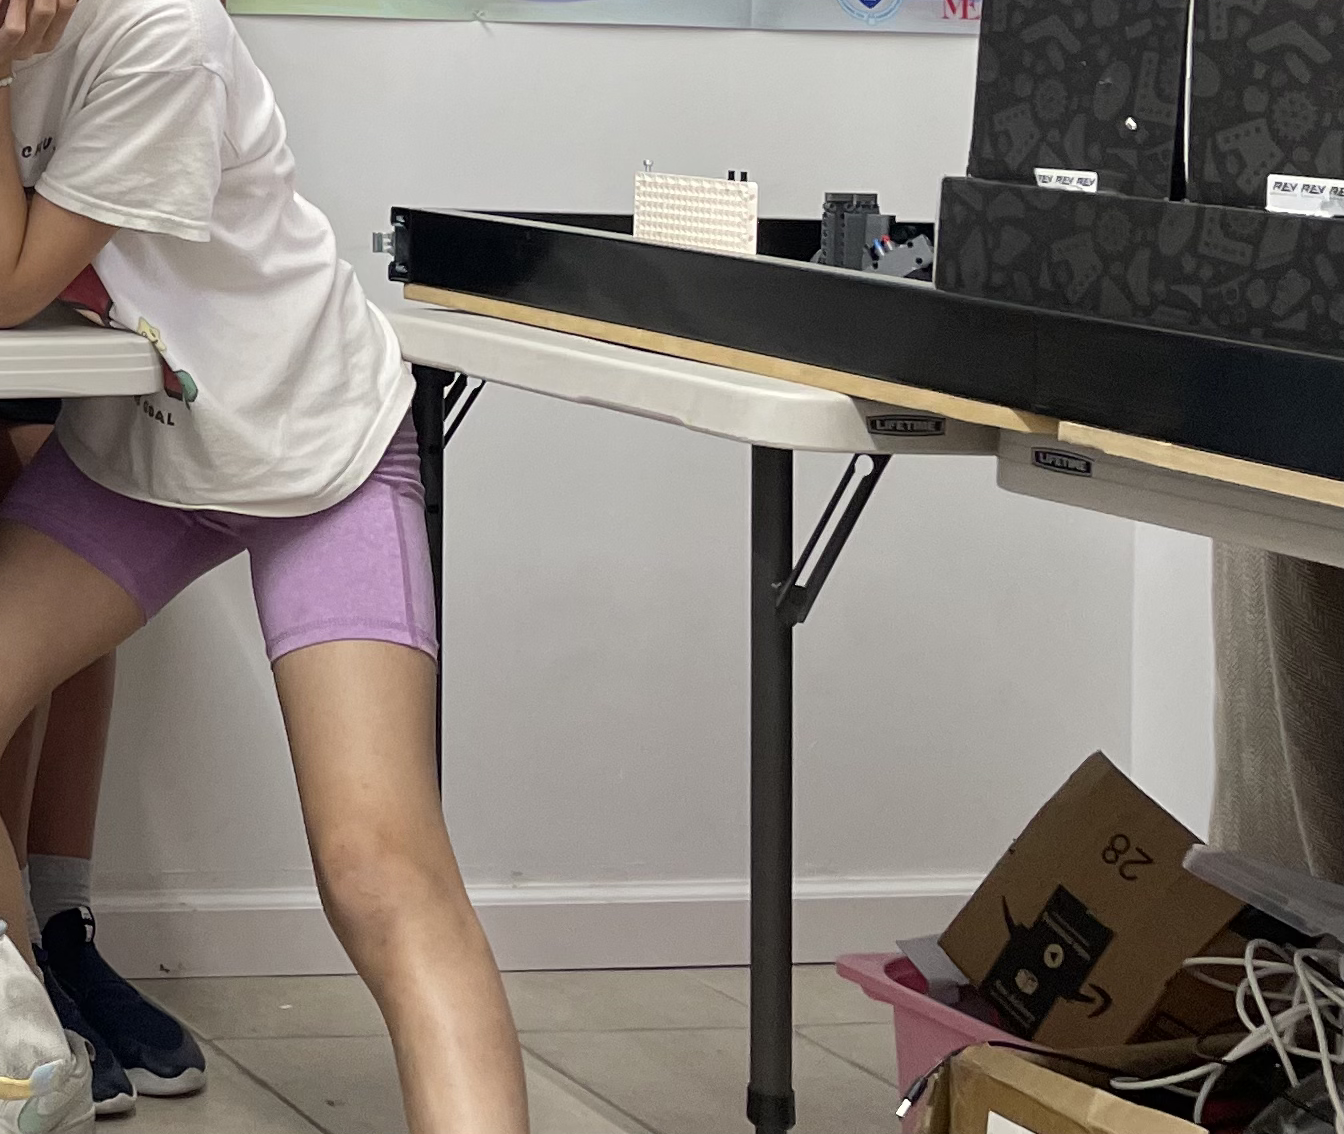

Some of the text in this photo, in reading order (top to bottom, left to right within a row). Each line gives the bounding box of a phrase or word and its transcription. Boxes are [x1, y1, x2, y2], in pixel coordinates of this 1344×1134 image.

[1076, 177, 1095, 188] REV
[1273, 181, 1326, 195] REV REV
[875, 418, 936, 432] LIFETIME
[1101, 834, 1154, 881] 28
